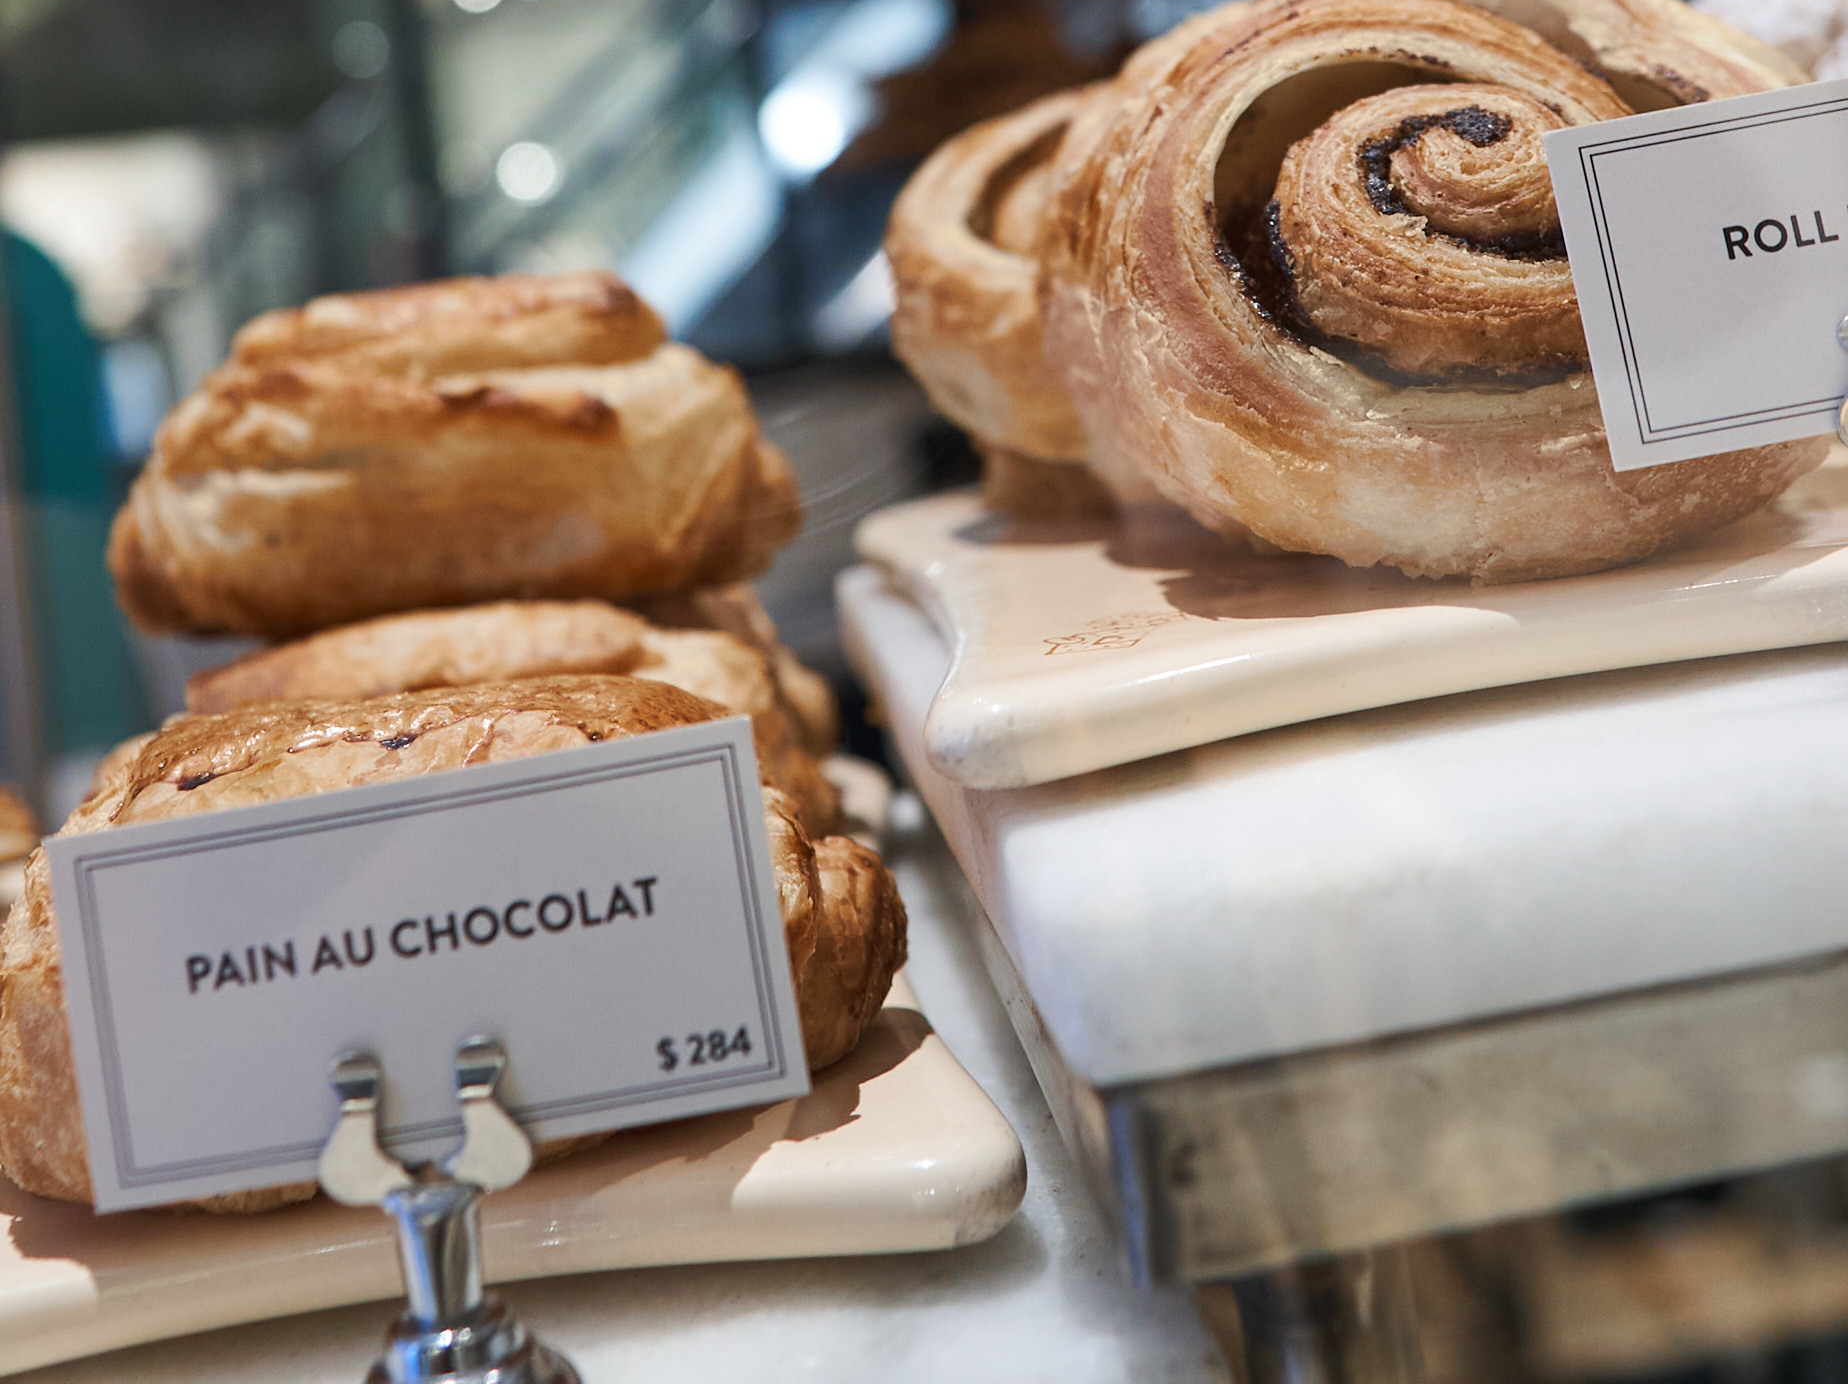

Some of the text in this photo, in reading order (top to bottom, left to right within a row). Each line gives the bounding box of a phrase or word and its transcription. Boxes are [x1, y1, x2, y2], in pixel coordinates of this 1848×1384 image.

[1723, 210, 1839, 260] ROLL
[185, 876, 660, 994] PAIN AU CHOCOLAT
